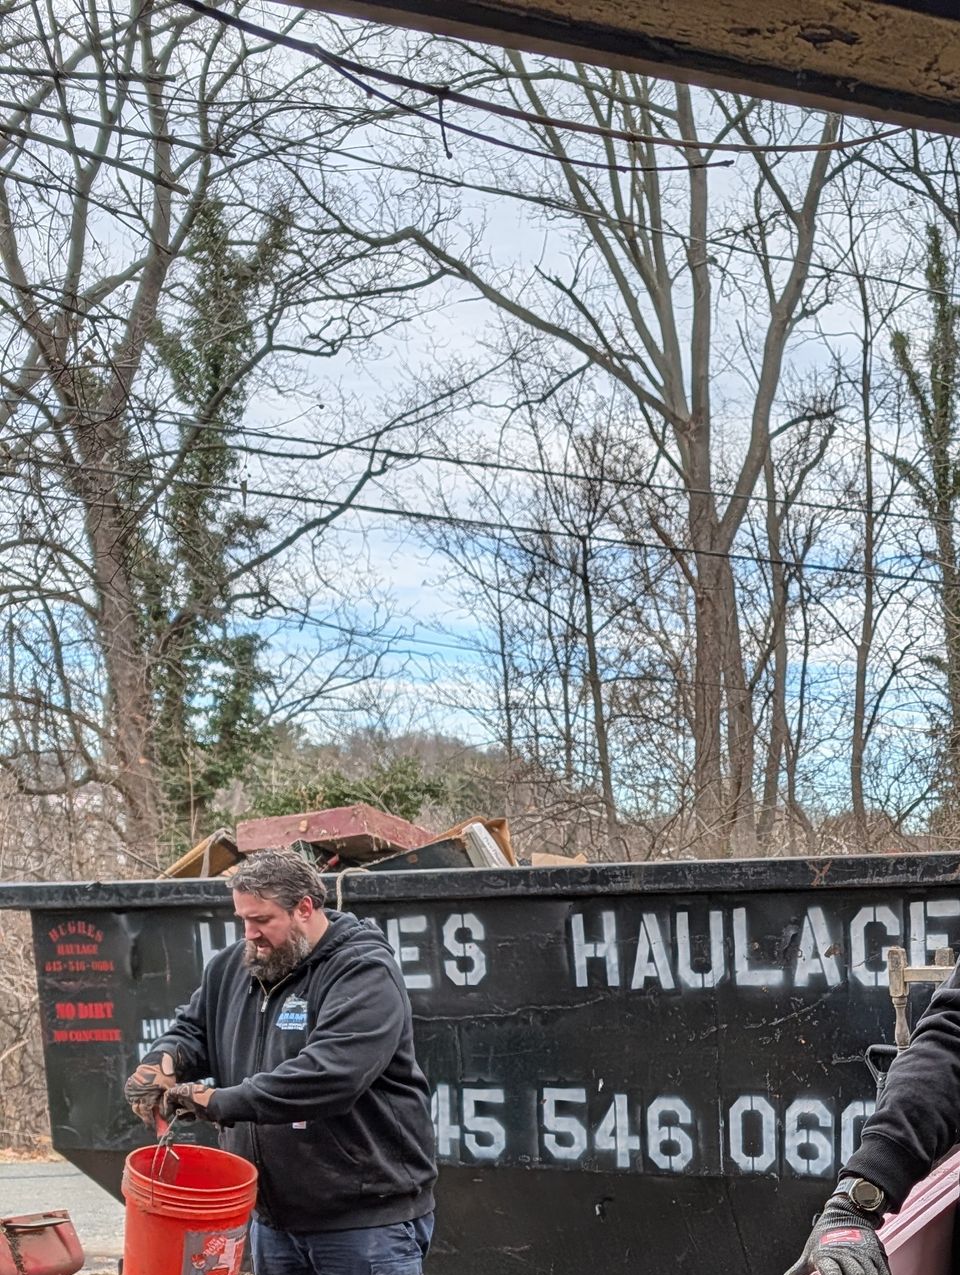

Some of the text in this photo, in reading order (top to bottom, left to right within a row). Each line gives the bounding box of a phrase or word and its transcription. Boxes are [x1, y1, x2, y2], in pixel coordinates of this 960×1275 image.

[55, 1002, 114, 1019] NO DIRT
[431, 1084, 506, 1159] 45
[542, 1088, 693, 1171] 546
